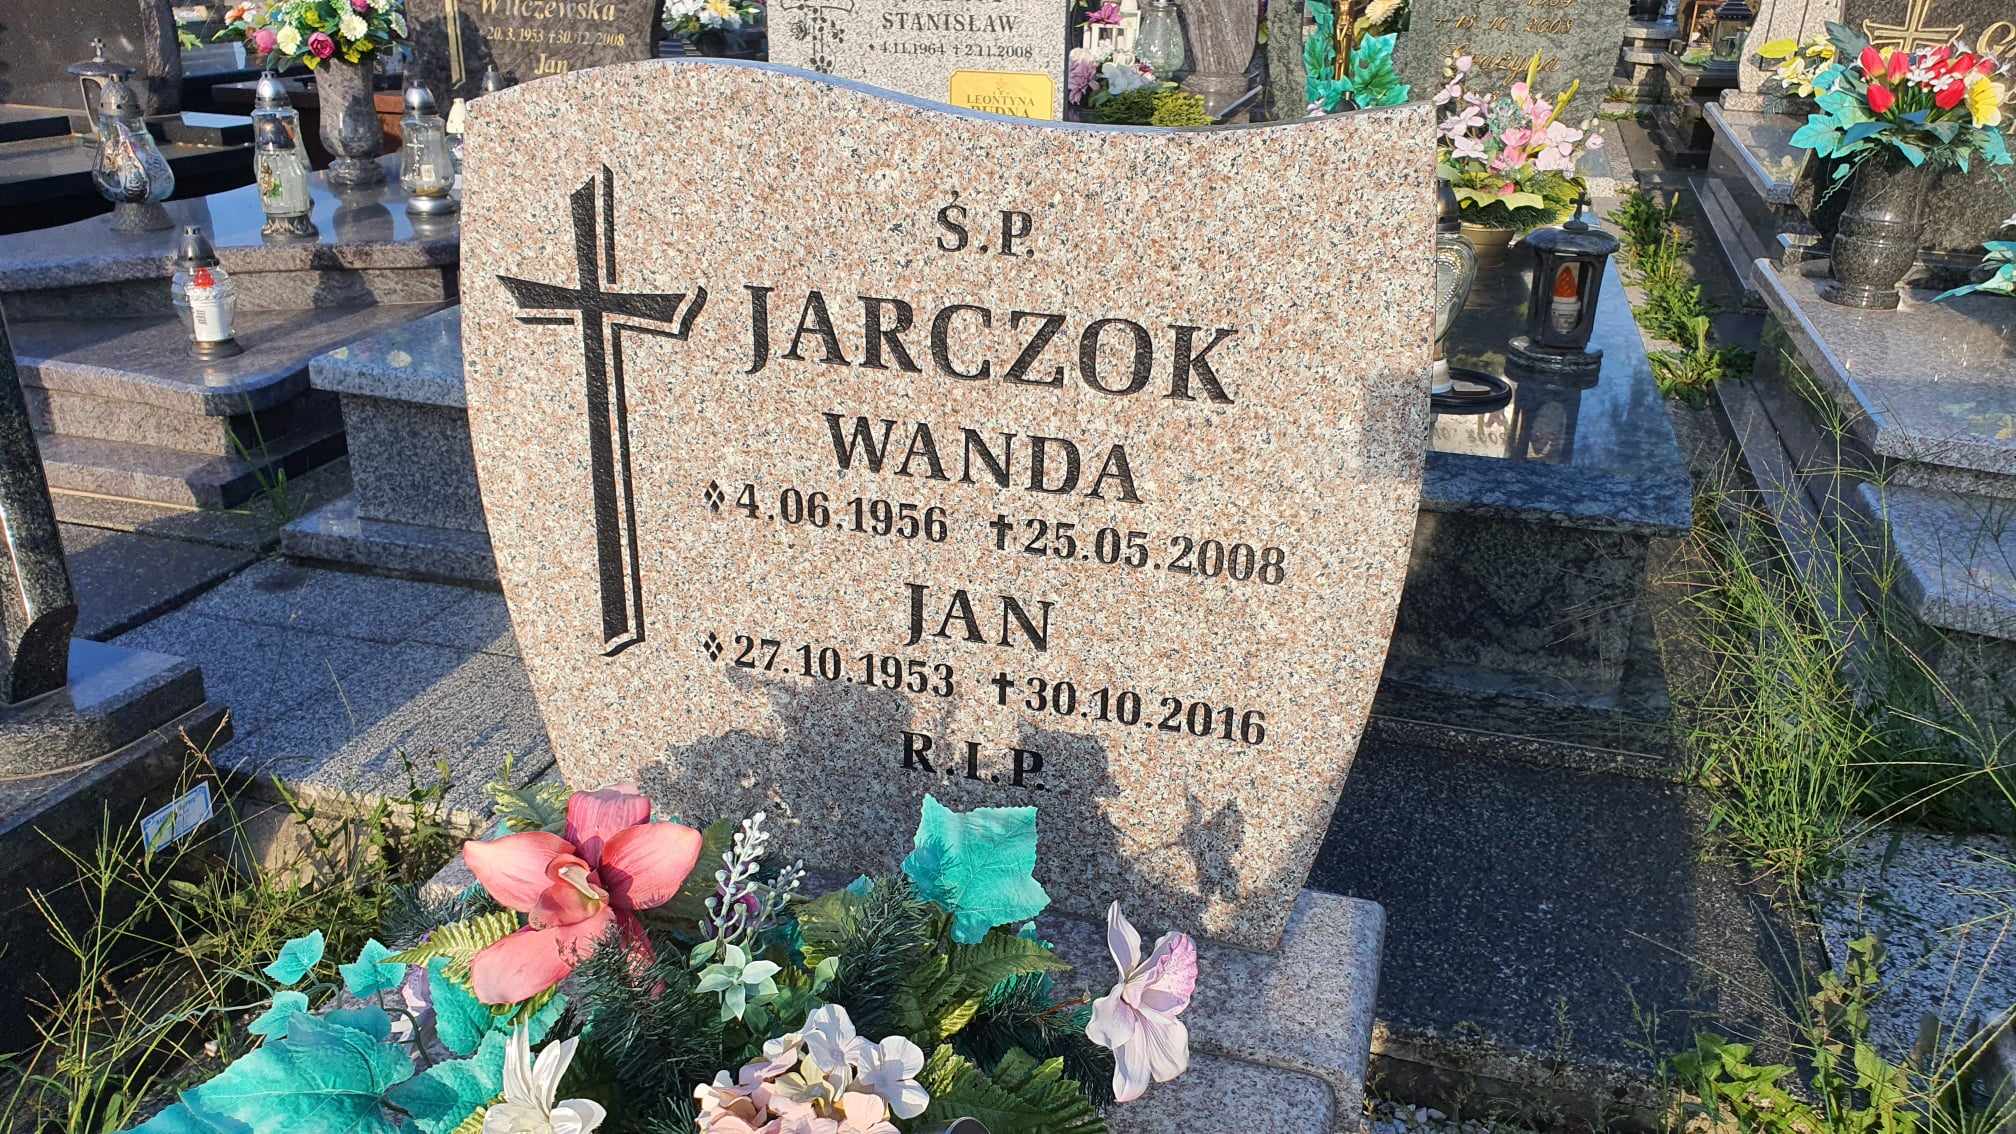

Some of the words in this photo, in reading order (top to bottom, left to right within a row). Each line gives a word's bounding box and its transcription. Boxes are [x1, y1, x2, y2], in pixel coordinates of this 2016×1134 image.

[882, 12, 1017, 33] STANISŁAW
[534, 53, 568, 75] Jan
[967, 94, 1035, 107] LEONTYNA
[936, 190, 1035, 258] Ś.P.
[742, 284, 1239, 405] JARCZOK
[822, 412, 1144, 504] WANDA
[735, 483, 949, 543] 4.06.1956
[1024, 518, 1286, 586] 25.05.2008
[903, 582, 1055, 653] JAN
[734, 635, 955, 698] 27.10.1953
[1025, 677, 1266, 746] 30.10.2016
[901, 730, 1051, 792] R.I.P.
